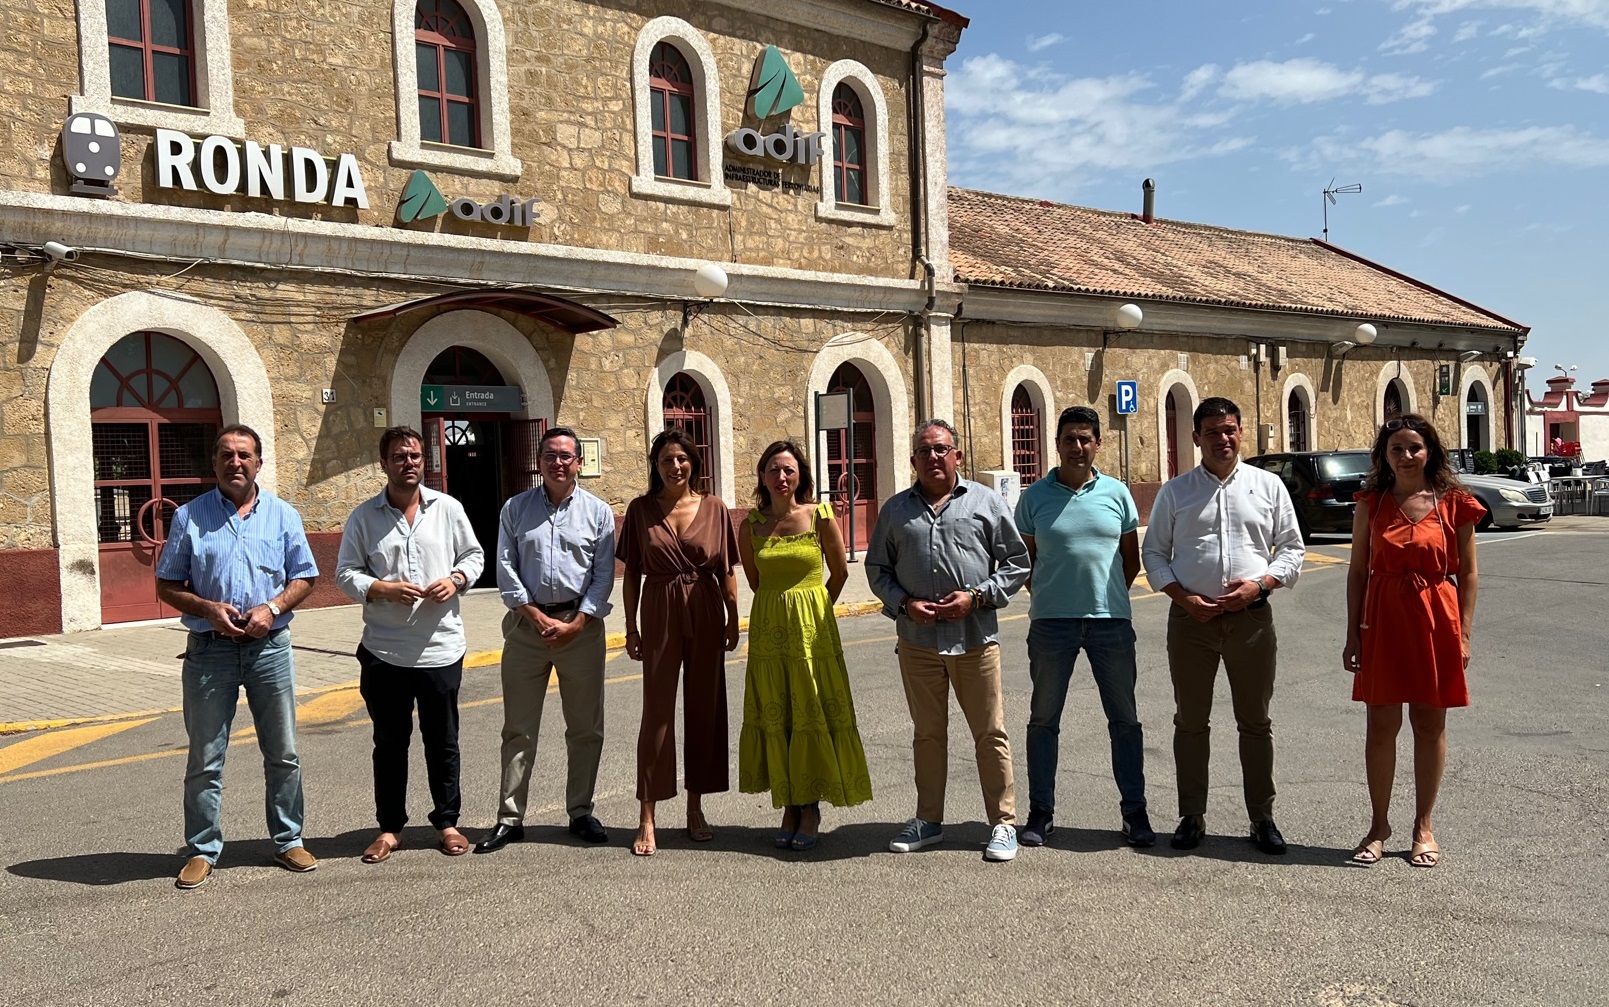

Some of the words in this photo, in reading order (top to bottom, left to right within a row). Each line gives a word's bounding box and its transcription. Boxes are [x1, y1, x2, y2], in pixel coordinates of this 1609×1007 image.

[726, 124, 826, 165] adif
[155, 128, 369, 209] RONDA
[725, 164, 772, 178] ADMINISTRADOR
[773, 171, 780, 180] DE
[725, 172, 780, 188] INFRAESTRUCTURAS
[451, 194, 543, 226] adif
[465, 390, 494, 400] Entrada
[1121, 384, 1134, 410] P
